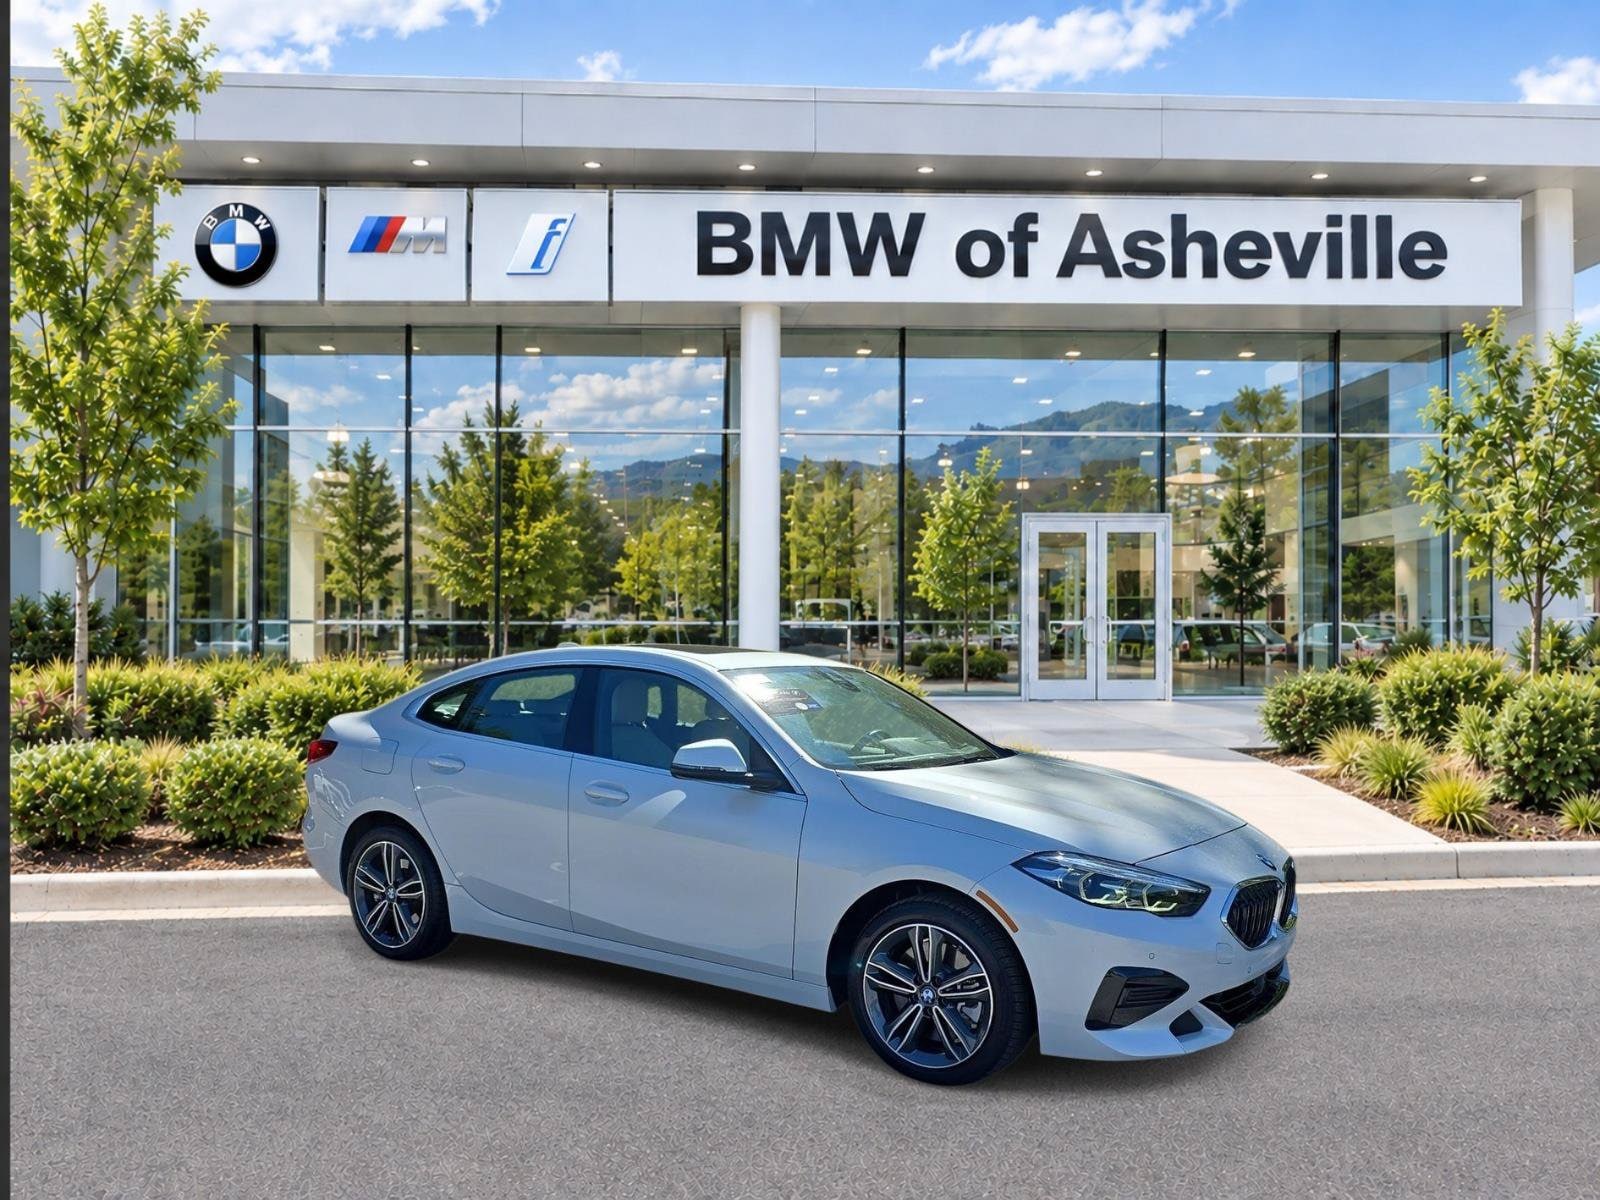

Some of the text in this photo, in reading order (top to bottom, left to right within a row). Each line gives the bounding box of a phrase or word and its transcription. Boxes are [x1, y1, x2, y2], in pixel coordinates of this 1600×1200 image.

[203, 204, 270, 230] BMW
[697, 211, 1448, 281] BMW of Asheville
